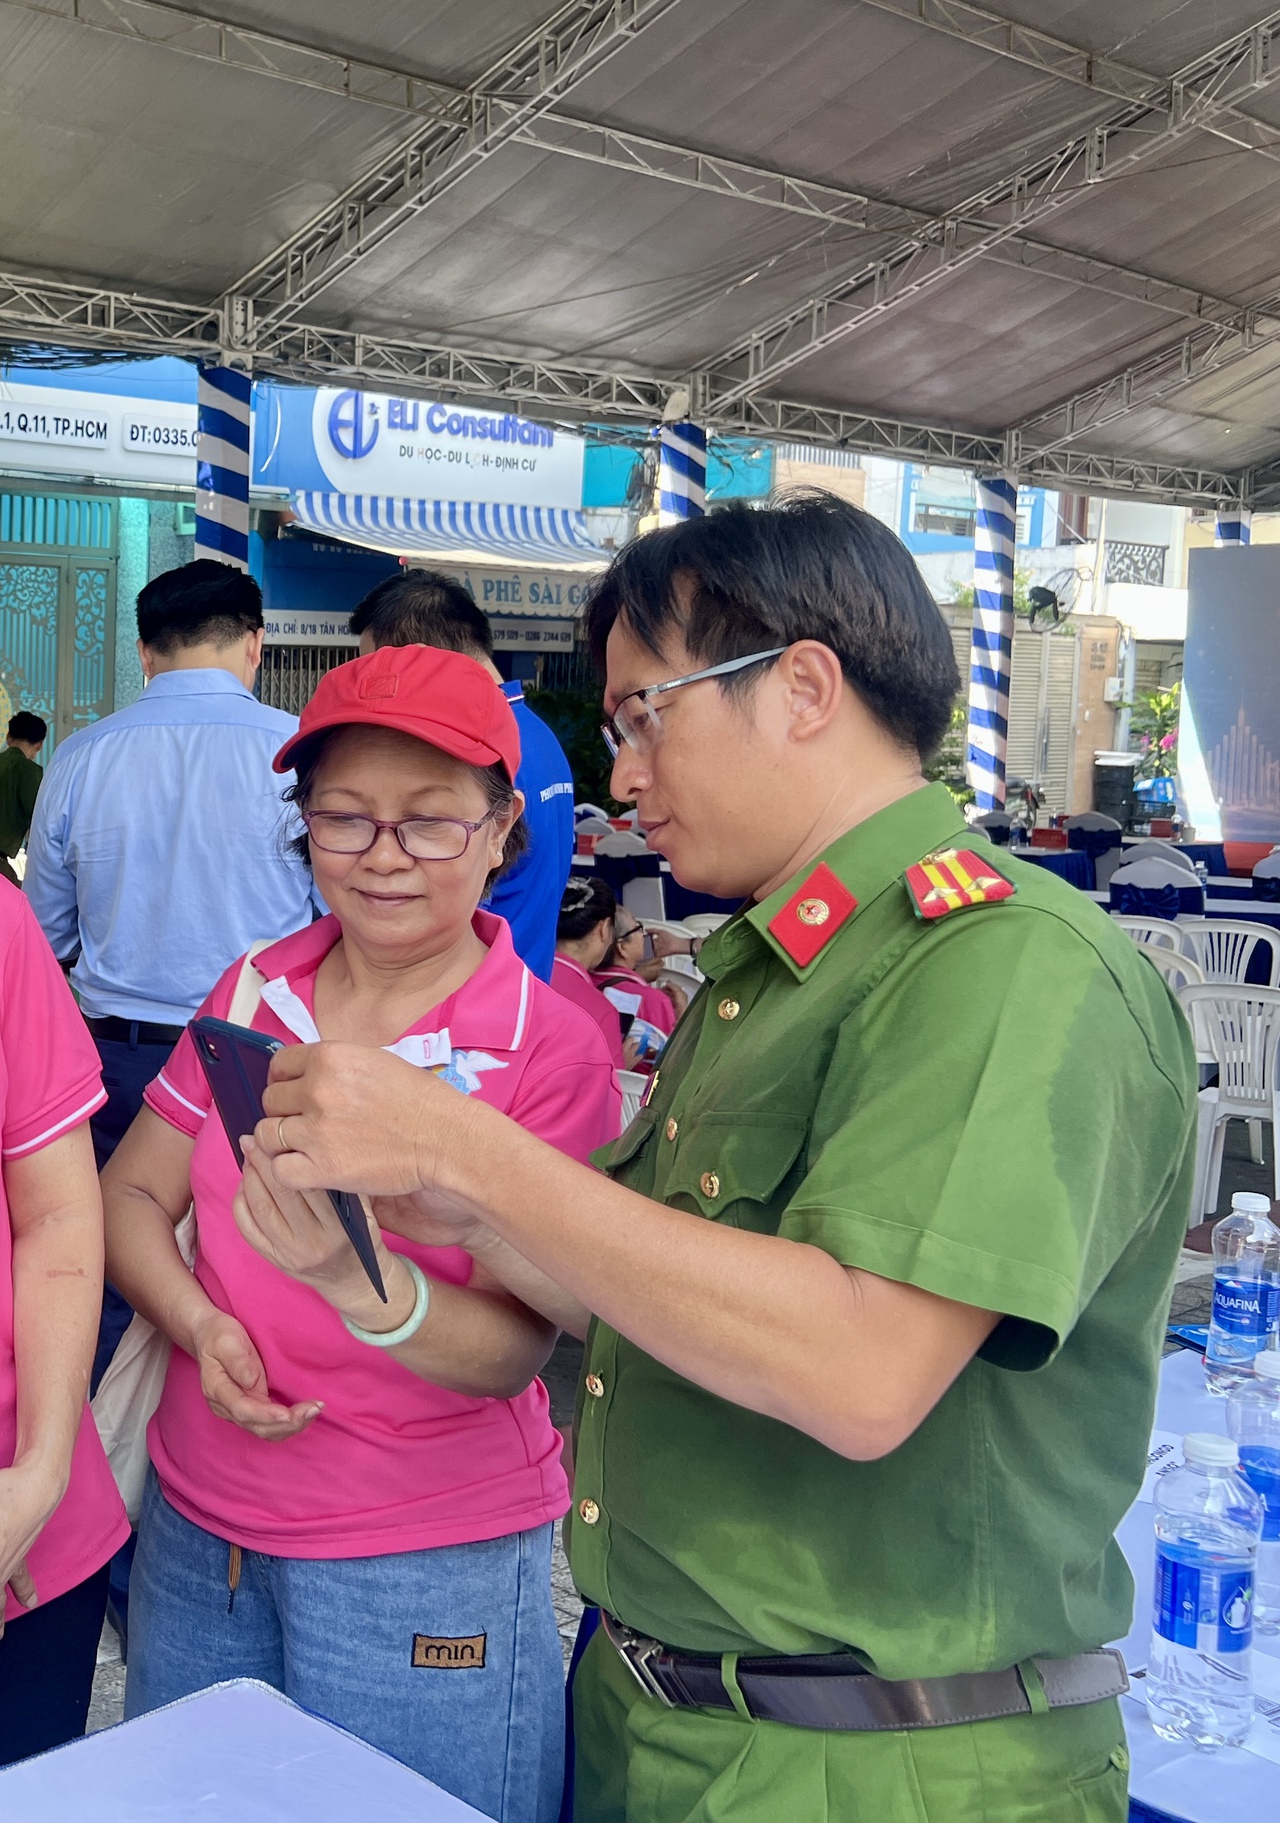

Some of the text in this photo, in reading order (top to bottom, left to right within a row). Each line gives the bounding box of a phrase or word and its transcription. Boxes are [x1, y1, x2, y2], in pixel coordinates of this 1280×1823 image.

[388, 399, 419, 431] ELI
[18, 414, 50, 438] Q.11,
[53, 417, 108, 440] TP.HCM
[400, 445, 413, 458] DU
[482, 574, 522, 603] PHÊ
[529, 577, 561, 605] SÀI
[320, 621, 335, 635] TÂN
[425, 1645, 475, 1660] min
